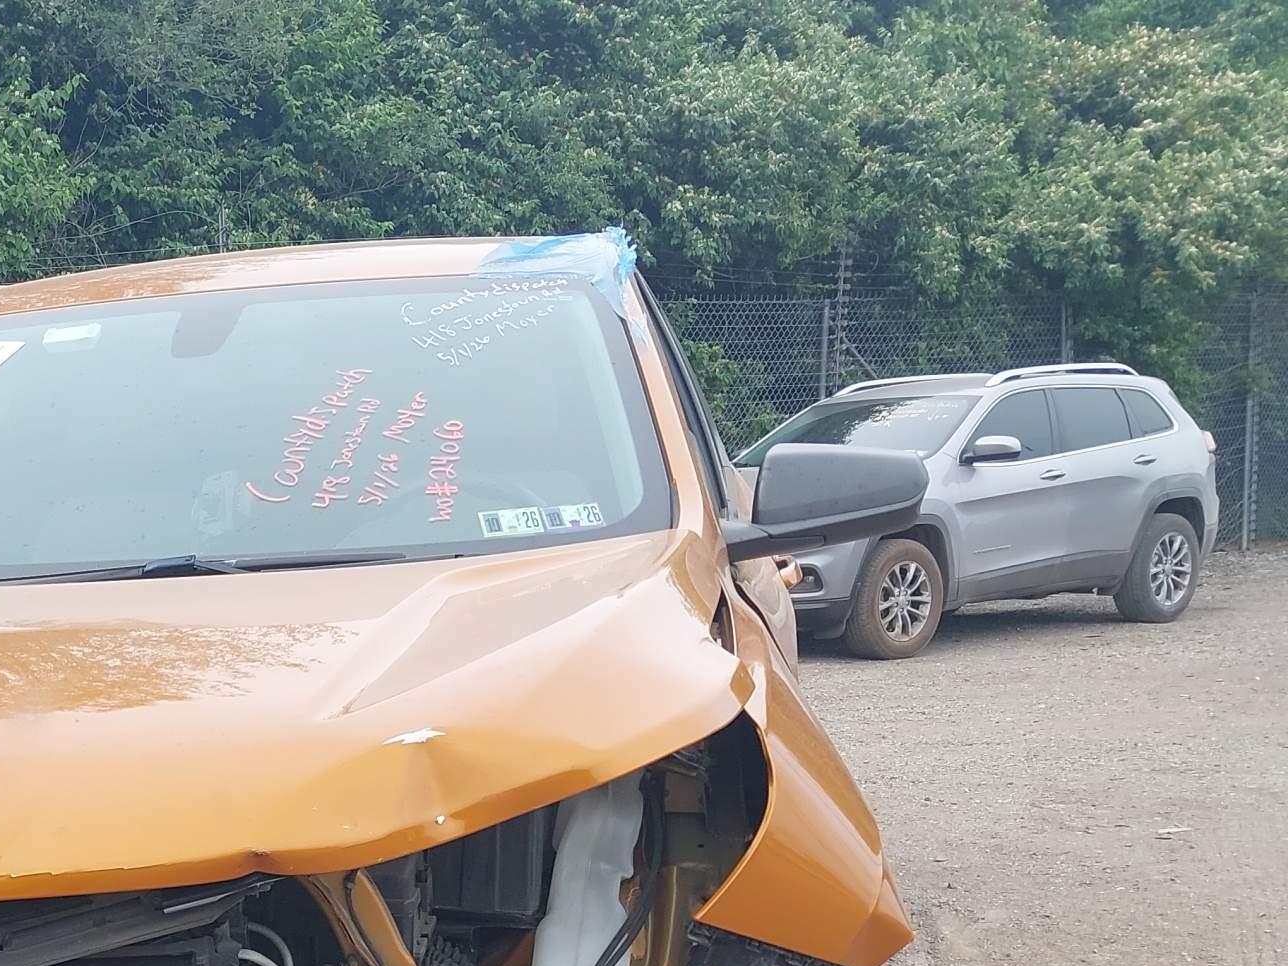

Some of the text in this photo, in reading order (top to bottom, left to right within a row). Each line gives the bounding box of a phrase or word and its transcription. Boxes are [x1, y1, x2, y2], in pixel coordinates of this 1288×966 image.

[412, 324, 456, 349] 418
[436, 335, 491, 366] 5/1/26
[312, 474, 351, 508] 418
[357, 453, 400, 506] 5/1/26
[522, 510, 540, 528] 26
[583, 505, 601, 523] 26
